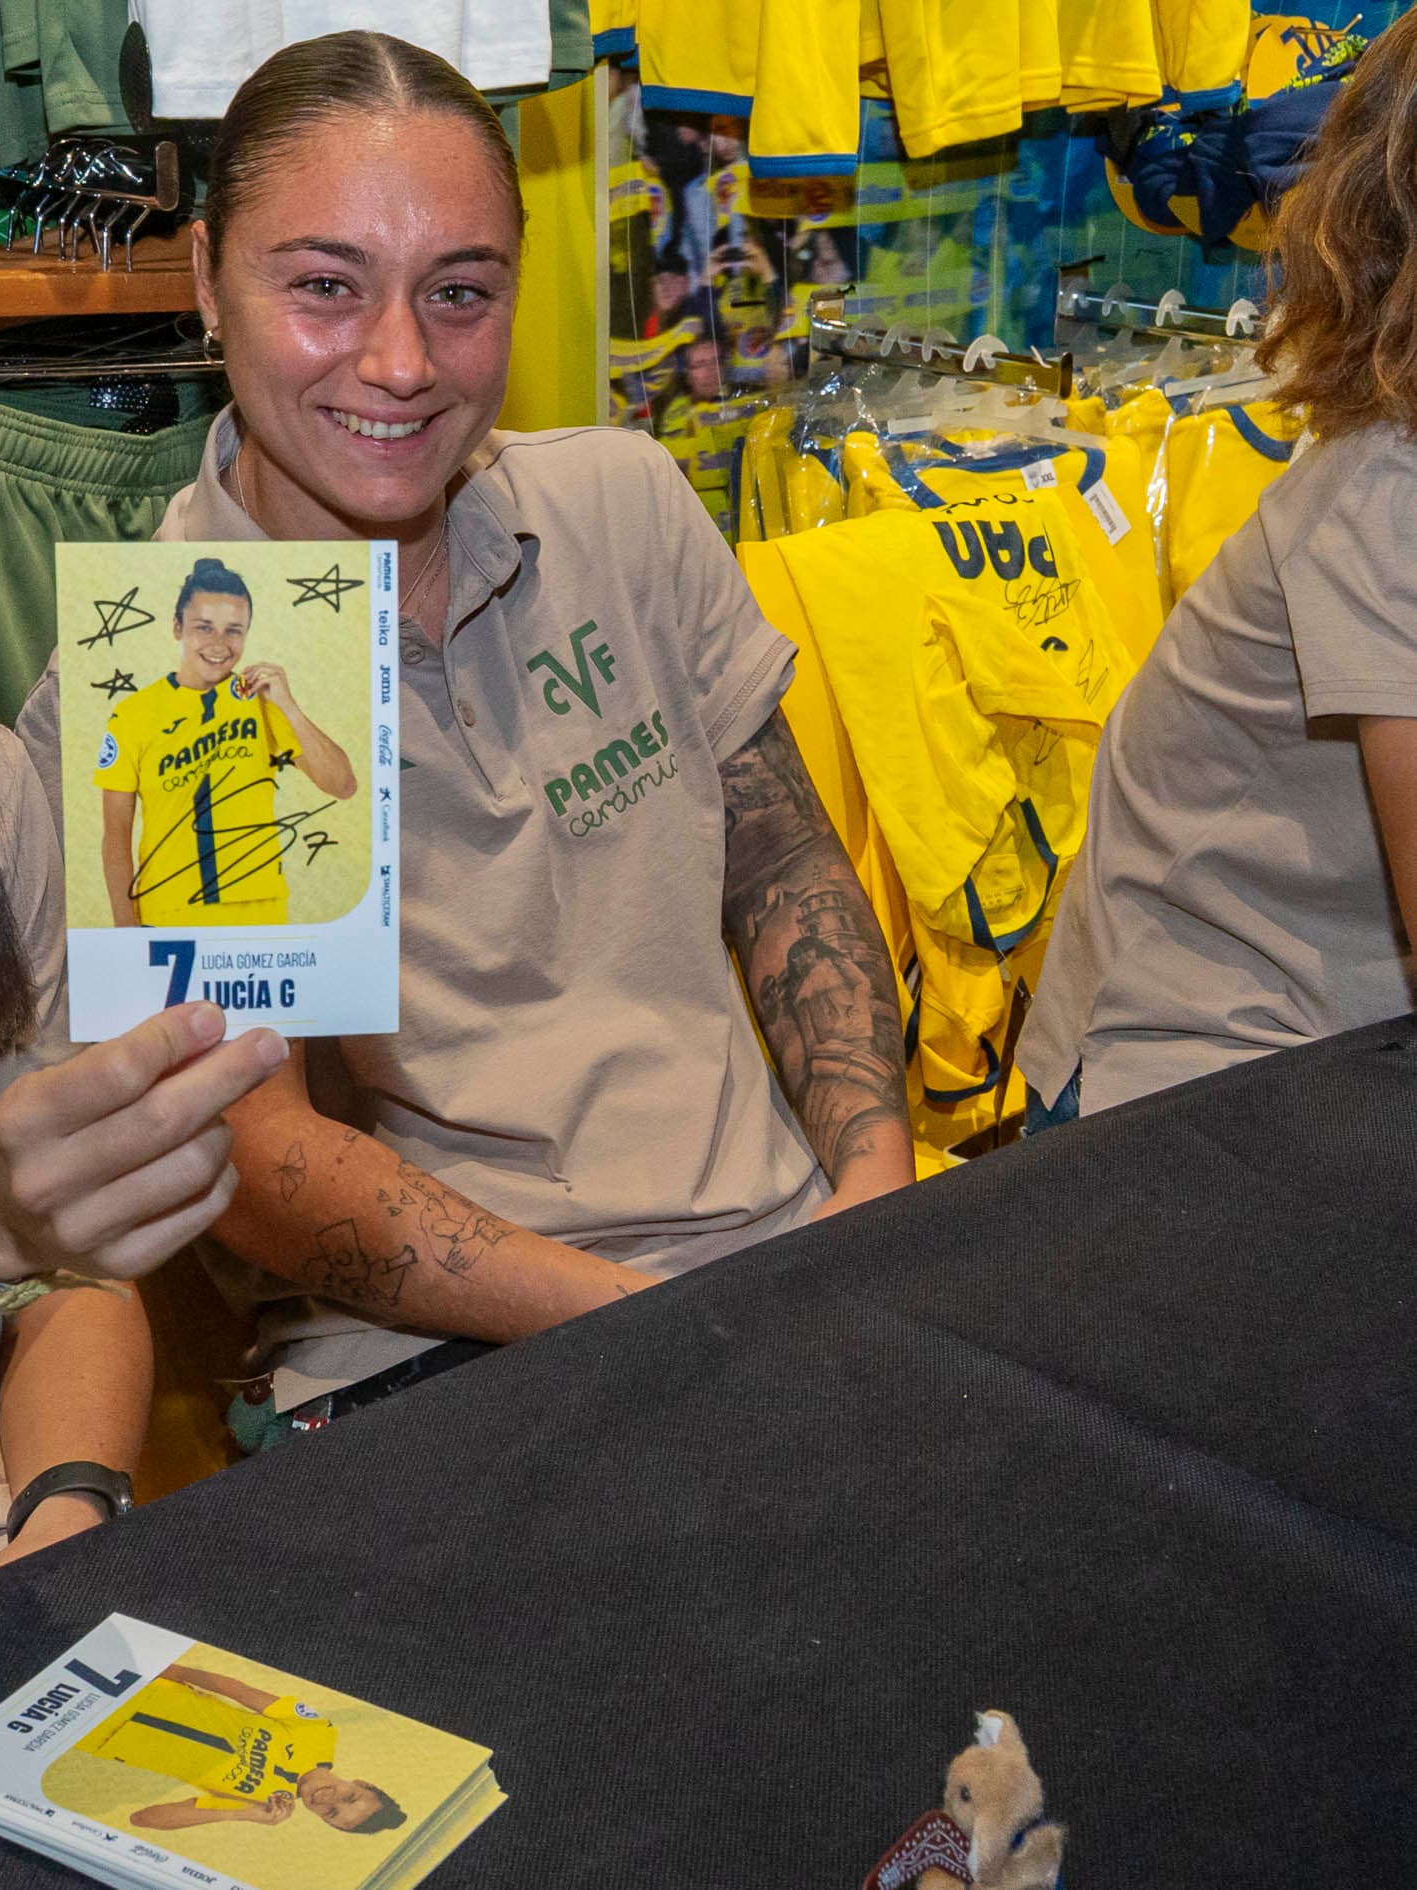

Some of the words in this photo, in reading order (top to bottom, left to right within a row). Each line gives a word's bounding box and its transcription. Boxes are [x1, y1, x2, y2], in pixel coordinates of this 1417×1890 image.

[378, 609, 390, 646] teika
[158, 717, 258, 776] PAMESA
[544, 709, 669, 817] PAMES
[569, 753, 679, 837] cerámic
[149, 940, 196, 1010] 7
[201, 951, 233, 970] LUCÍA
[236, 951, 274, 970] GÓMEZ
[277, 948, 317, 968] GARCÍA
[280, 978, 295, 1008] G
[64, 1658, 142, 1698] 7
[20, 1683, 81, 1721] LUCÍA
[7, 1720, 34, 1734] G
[234, 1728, 272, 1794] PAMESA
